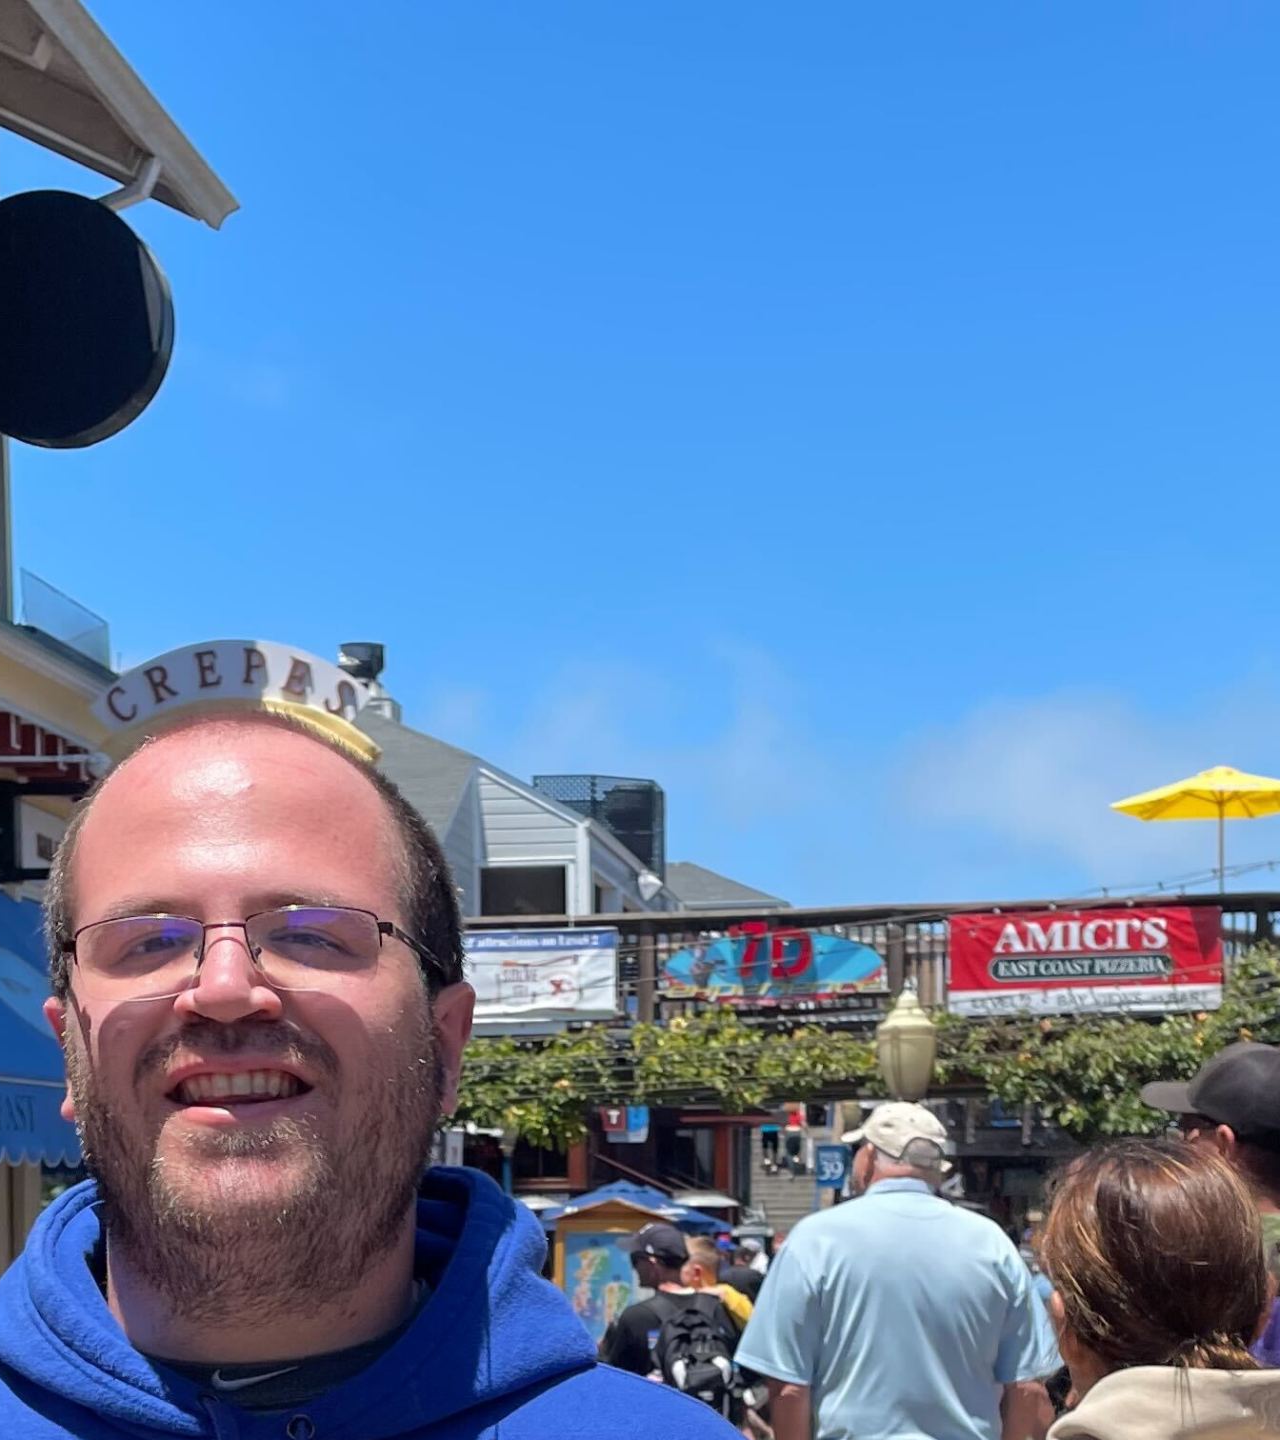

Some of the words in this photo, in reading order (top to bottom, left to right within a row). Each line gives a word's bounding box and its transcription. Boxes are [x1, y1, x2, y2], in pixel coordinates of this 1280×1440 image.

[107, 647, 357, 722] CREPES
[728, 921, 813, 980] 7D
[993, 917, 1168, 953] AMICI'S
[998, 960, 1038, 977] EAST
[1039, 959, 1092, 976] COAST
[1093, 956, 1167, 975] PIZZERIA
[818, 1161, 845, 1181] 39
